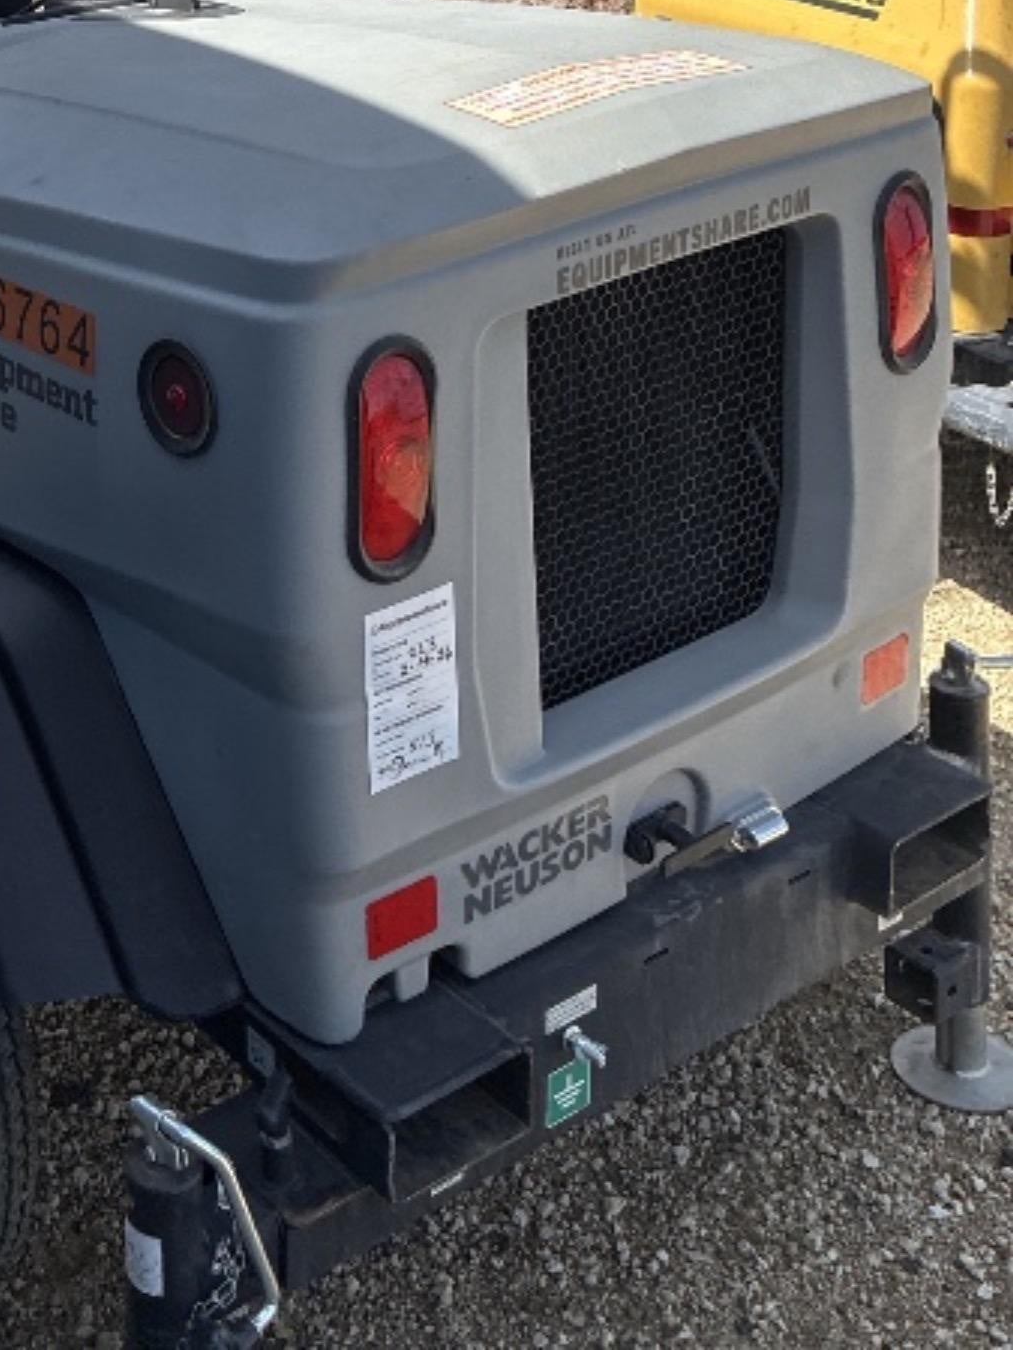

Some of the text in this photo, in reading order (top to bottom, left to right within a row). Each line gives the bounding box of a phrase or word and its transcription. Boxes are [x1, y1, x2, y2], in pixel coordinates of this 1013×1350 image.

[556, 185, 811, 295] EQUIPMENTSHARE.COM
[460, 794, 612, 889] WACKER
[463, 824, 612, 925] NEUSON
